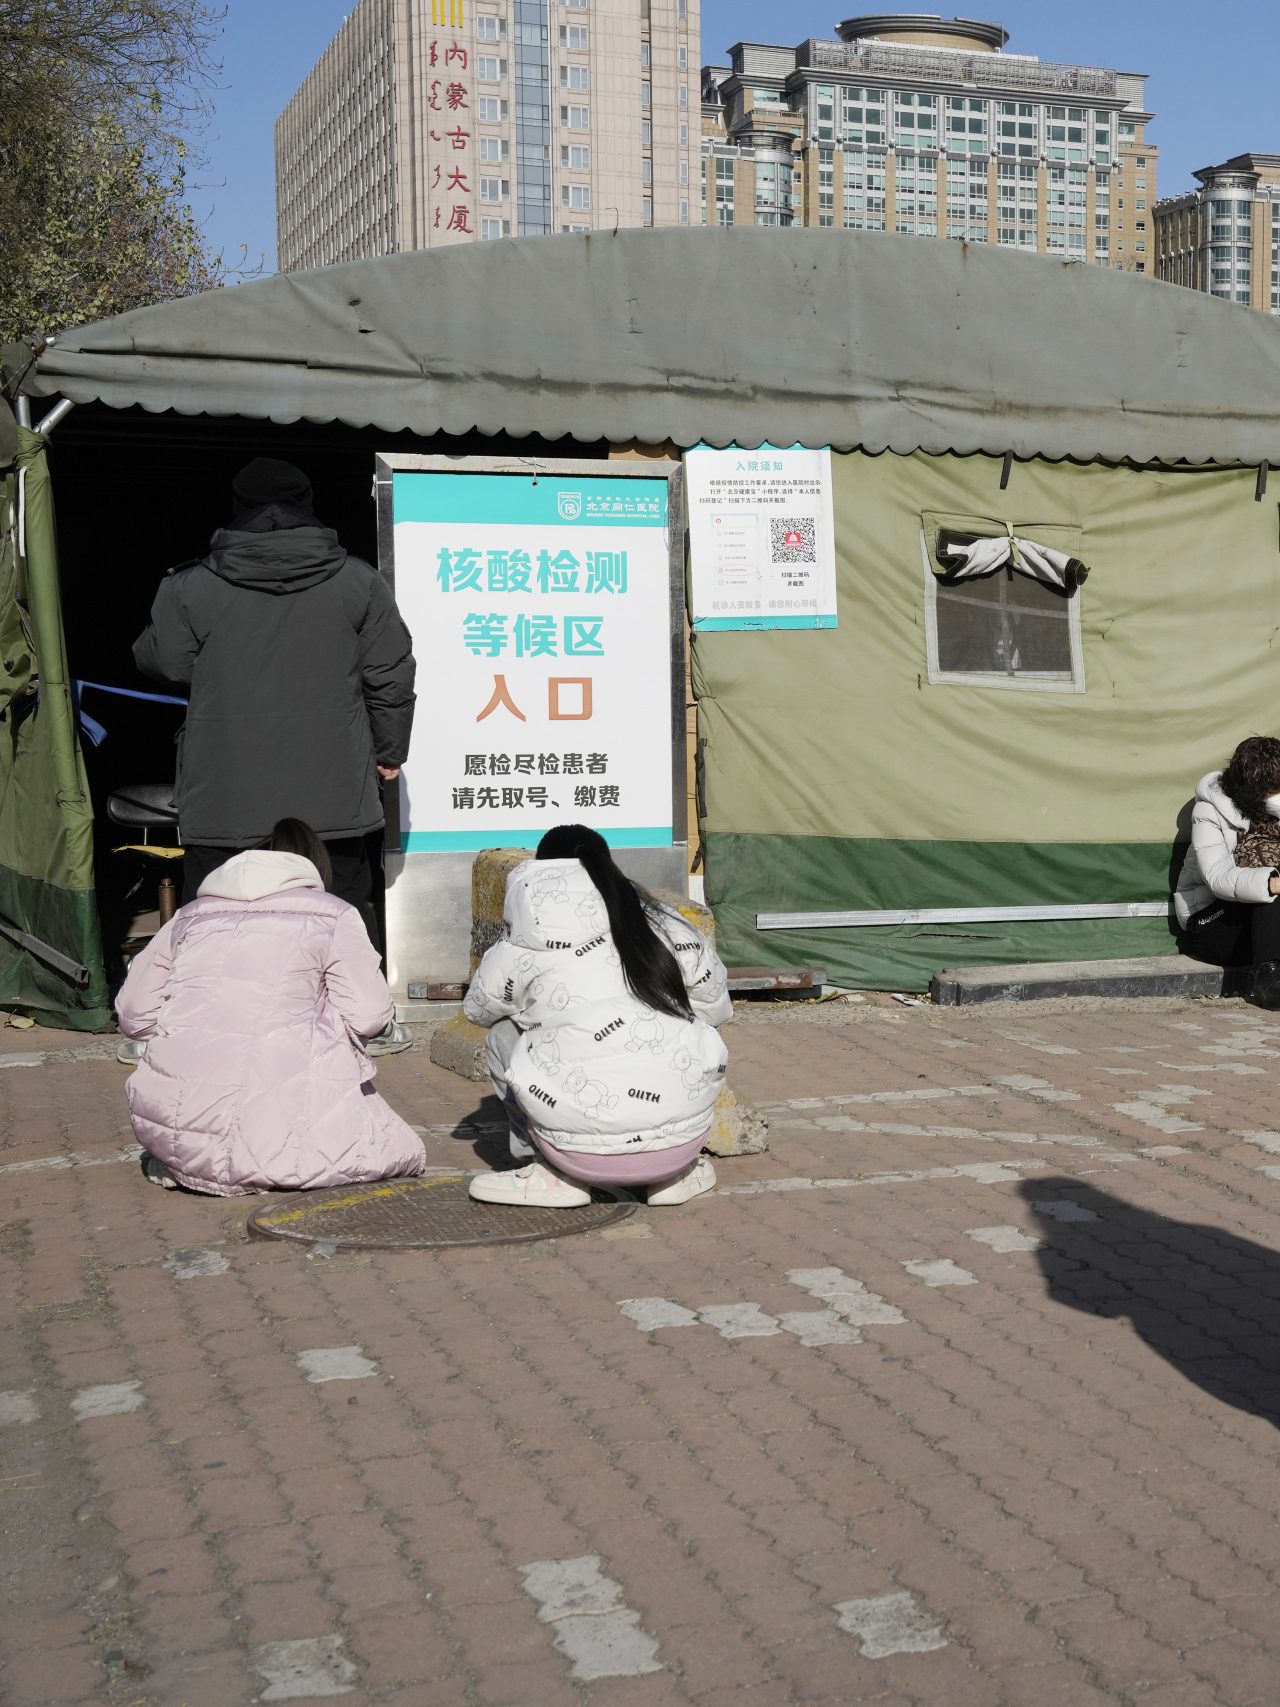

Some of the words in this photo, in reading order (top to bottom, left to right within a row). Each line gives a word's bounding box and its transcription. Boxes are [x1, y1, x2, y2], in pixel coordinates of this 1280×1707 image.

[445, 41, 473, 234] 内蒙古大厦
[735, 461, 784, 472] 入院须知
[586, 502, 660, 513] 北京同仁医院
[436, 547, 628, 595] 核酸检测
[462, 611, 606, 658] 等候区
[476, 674, 593, 723] 入口
[463, 752, 609, 777] 愿检尽检患者
[451, 783, 621, 810] 请先取号、缴费
